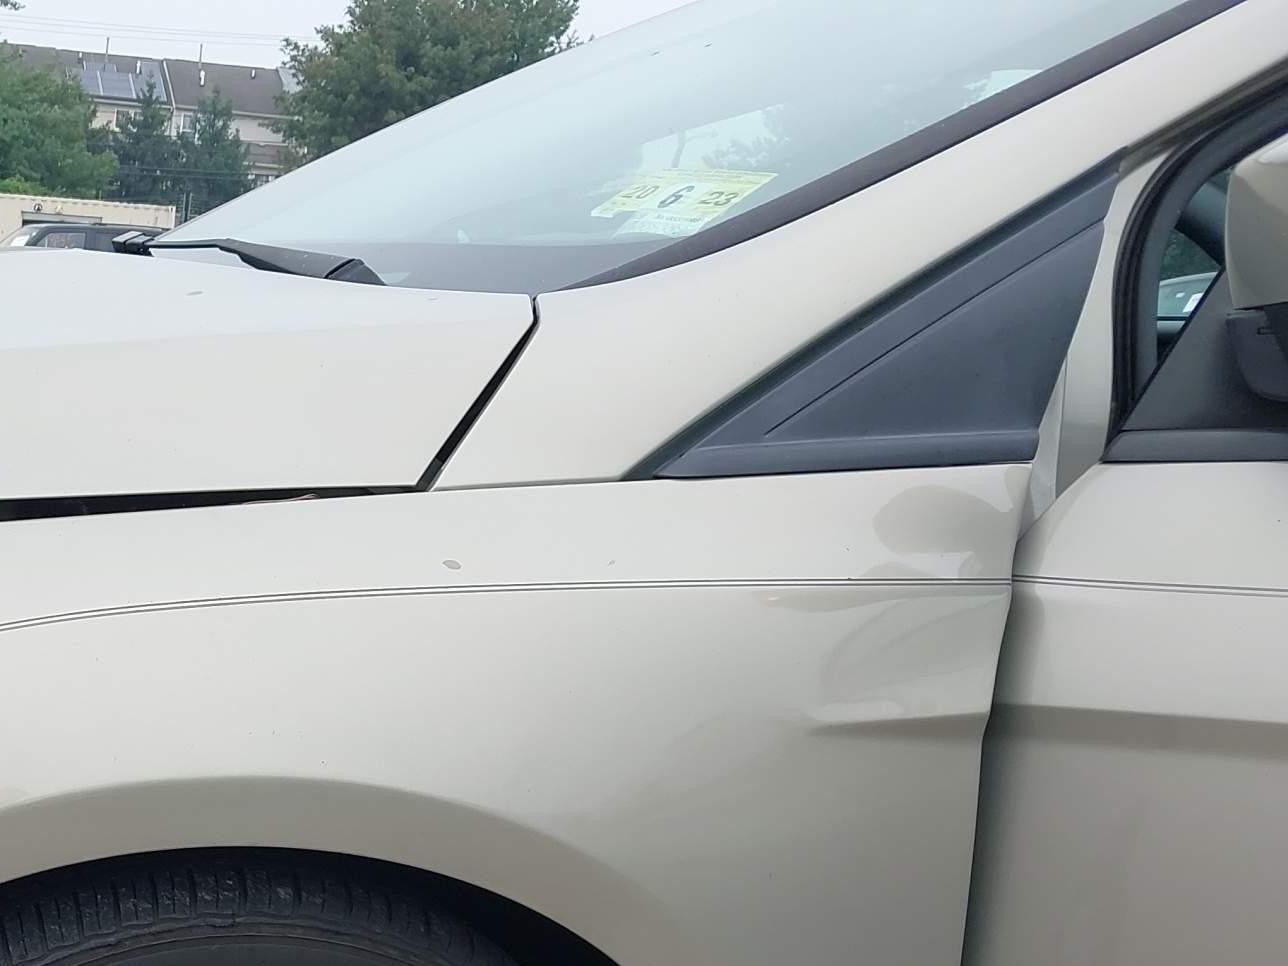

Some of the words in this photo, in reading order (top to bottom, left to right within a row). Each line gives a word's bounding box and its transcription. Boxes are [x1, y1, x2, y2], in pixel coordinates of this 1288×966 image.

[621, 185, 661, 200] 20
[656, 185, 696, 209] 6
[699, 191, 740, 207] 23
